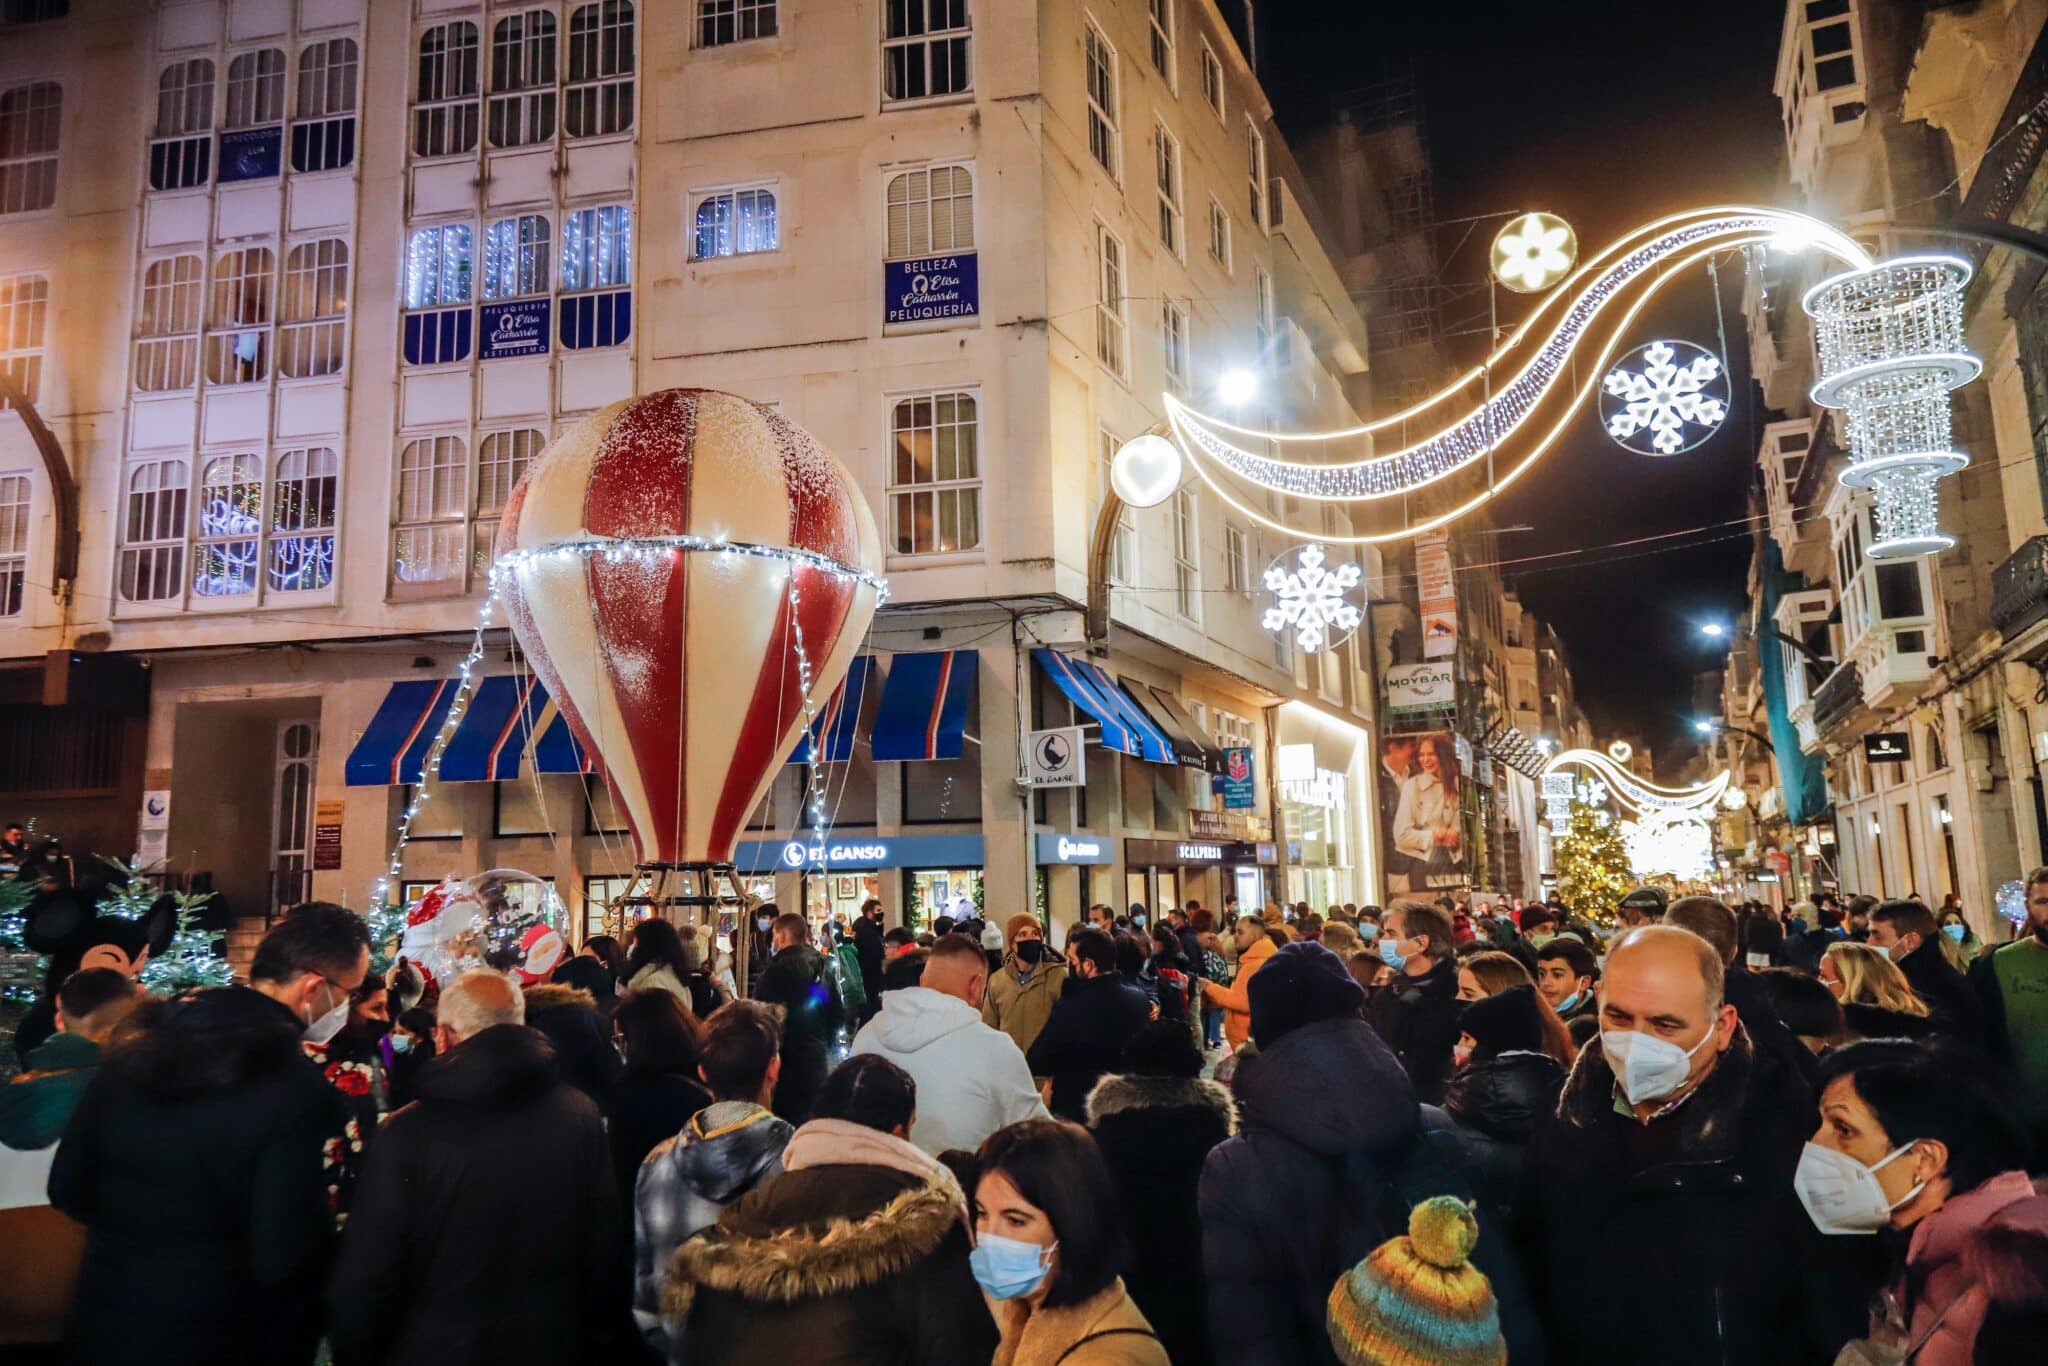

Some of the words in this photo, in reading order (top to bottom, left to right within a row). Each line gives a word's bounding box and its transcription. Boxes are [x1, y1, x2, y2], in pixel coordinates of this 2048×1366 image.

[904, 258, 958, 273] BELLEZA
[930, 275, 960, 291] Elisa
[890, 301, 974, 320] PELUQUERÍA
[515, 314, 540, 328] Elisa
[484, 345, 546, 358] ESTILISMO
[1389, 673, 1451, 688] MOYBAR
[809, 847, 827, 861] EL
[830, 846, 886, 860] GANSO
